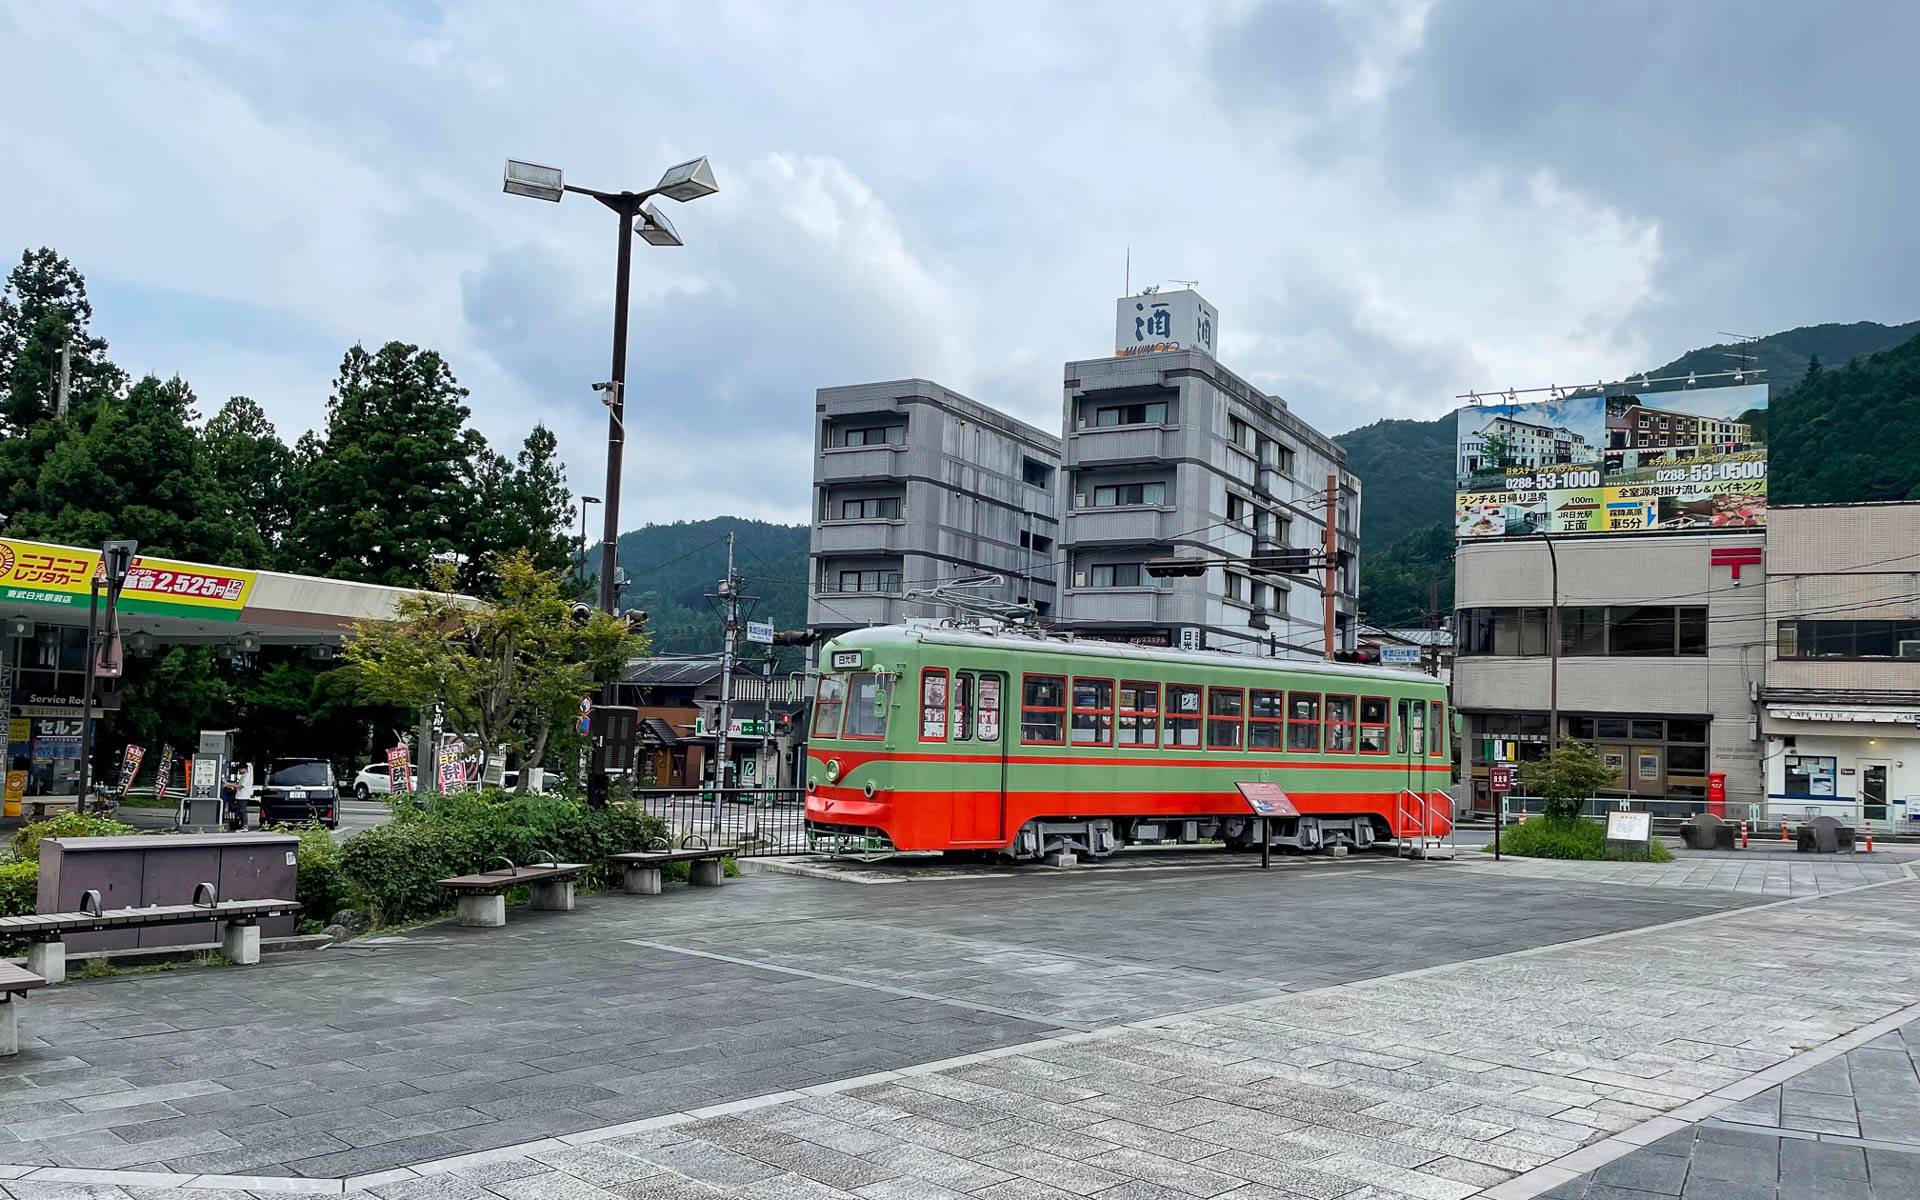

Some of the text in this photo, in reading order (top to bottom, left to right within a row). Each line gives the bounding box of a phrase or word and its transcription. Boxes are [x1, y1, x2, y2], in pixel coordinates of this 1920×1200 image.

[1656, 461, 1765, 483] 0288-53-0500
[1505, 470, 1600, 490] 0288-53-1000
[1459, 492, 1548, 505] ランチ&日帰り温泉
[1558, 510, 1593, 519] JR日光駅
[1563, 520, 1588, 531] 正面
[1610, 518, 1642, 529] 車5分
[18, 554, 88, 574] ニコニコ
[13, 568, 82, 585] レンタカー
[229, 580, 242, 590] 12
[6, 589, 72, 604] 東武日光駅前店
[30, 694, 67, 704] Service
[38, 719, 84, 735] セルフ
